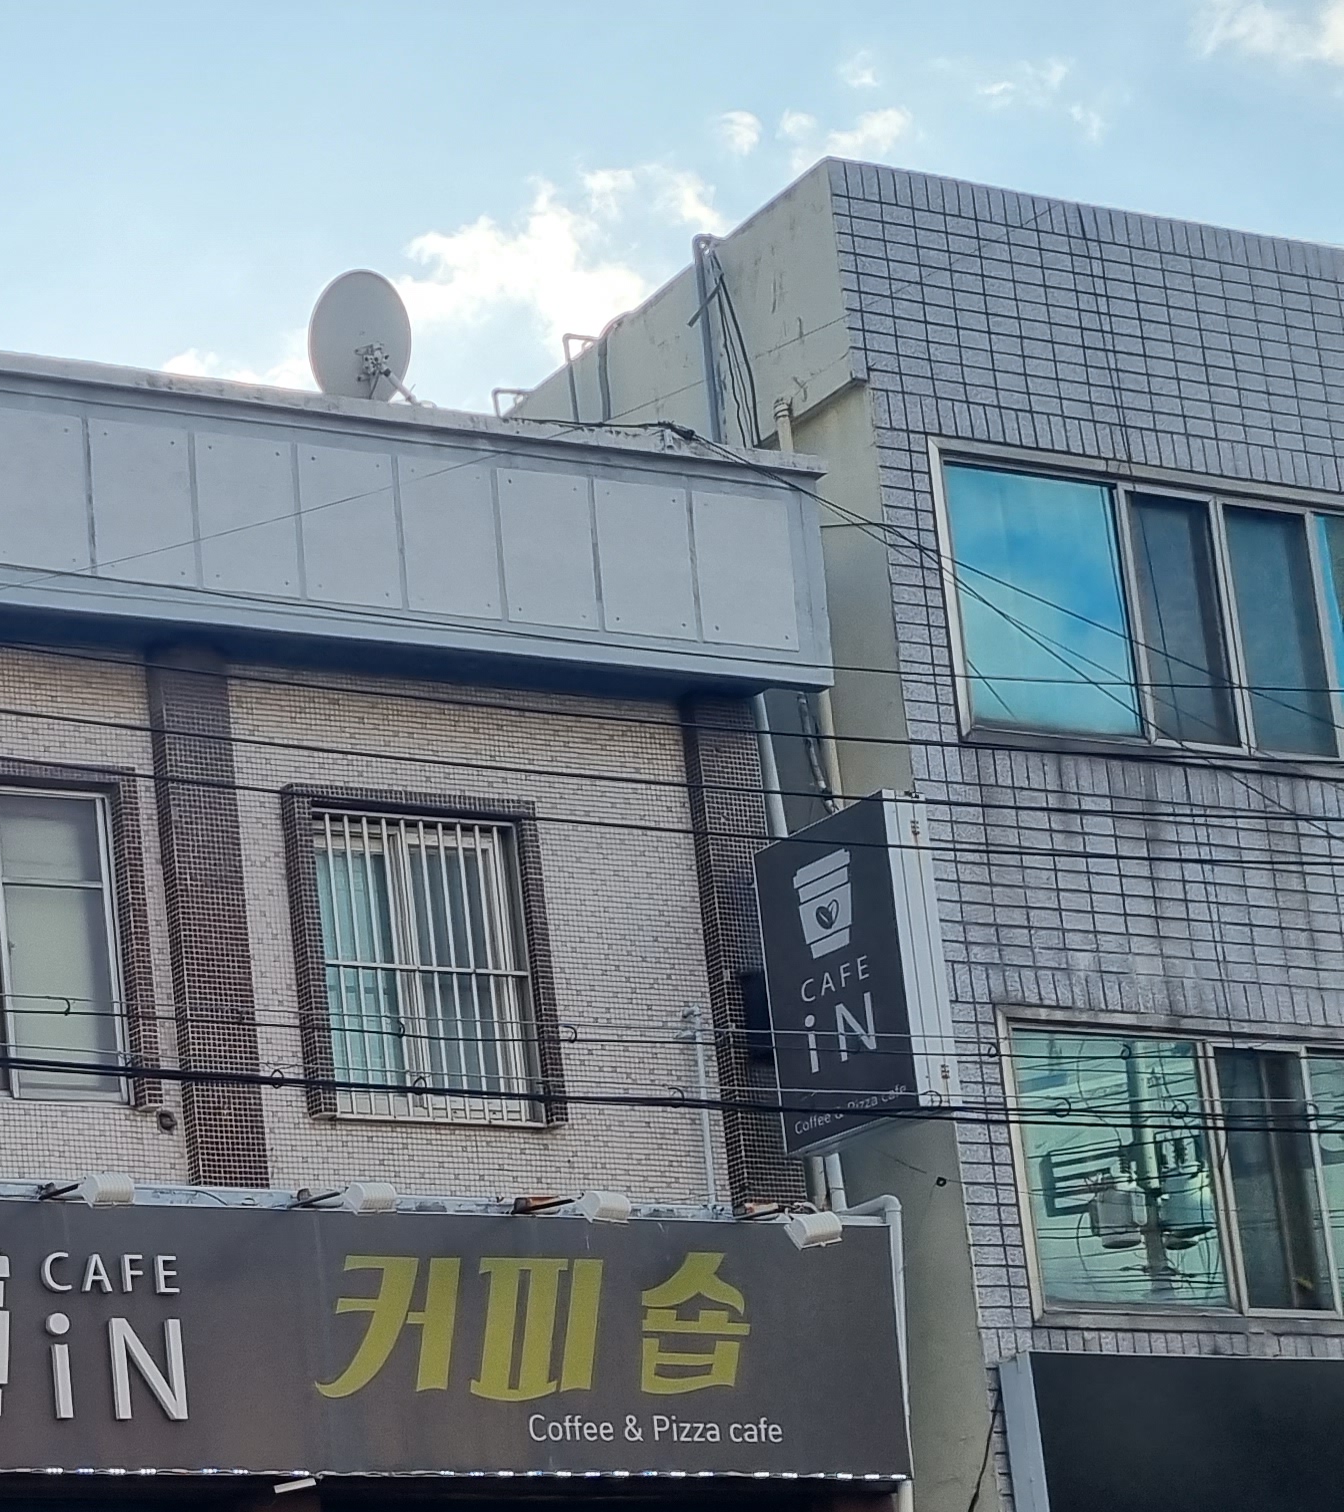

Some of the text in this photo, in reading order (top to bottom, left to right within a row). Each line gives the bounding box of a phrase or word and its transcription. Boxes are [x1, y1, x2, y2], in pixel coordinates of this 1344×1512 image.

[801, 955, 870, 1002] CAFE
[794, 1112, 831, 1135] Coffee
[40, 1251, 181, 1294] CAFE
[45, 1312, 189, 1421] iN
[528, 1414, 784, 1443] Coffee & Pizza cafe
